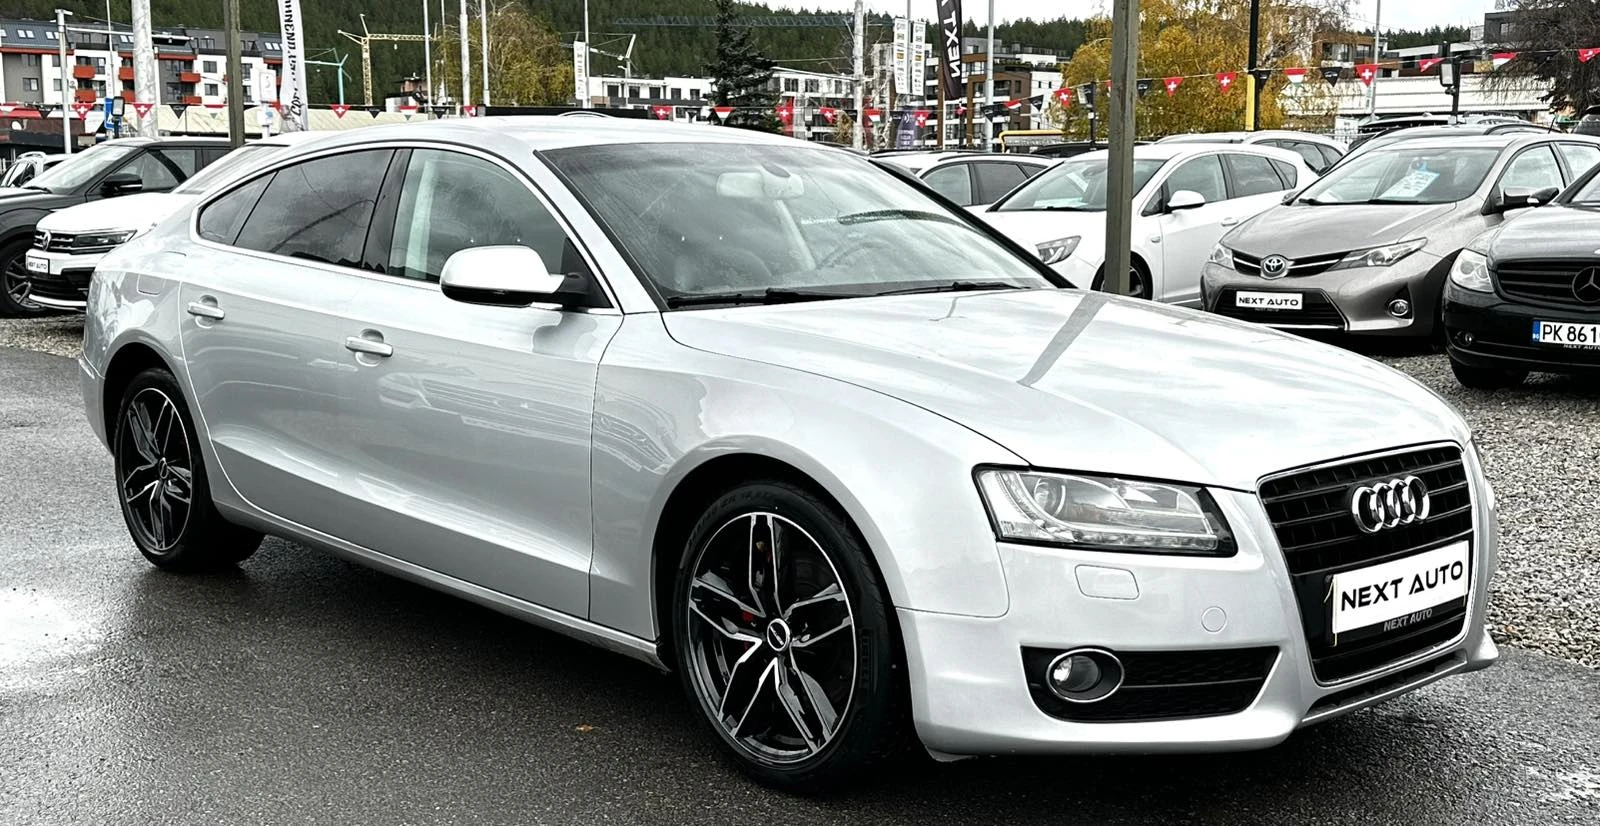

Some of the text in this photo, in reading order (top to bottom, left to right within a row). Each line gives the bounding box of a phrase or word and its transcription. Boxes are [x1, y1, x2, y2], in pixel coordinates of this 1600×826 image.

[1239, 297, 1299, 306] NEXT AUTO
[1543, 324, 1600, 343] PK 861
[1341, 560, 1463, 611] NEXT AUTO
[1383, 608, 1433, 632] NEXT AUTO
